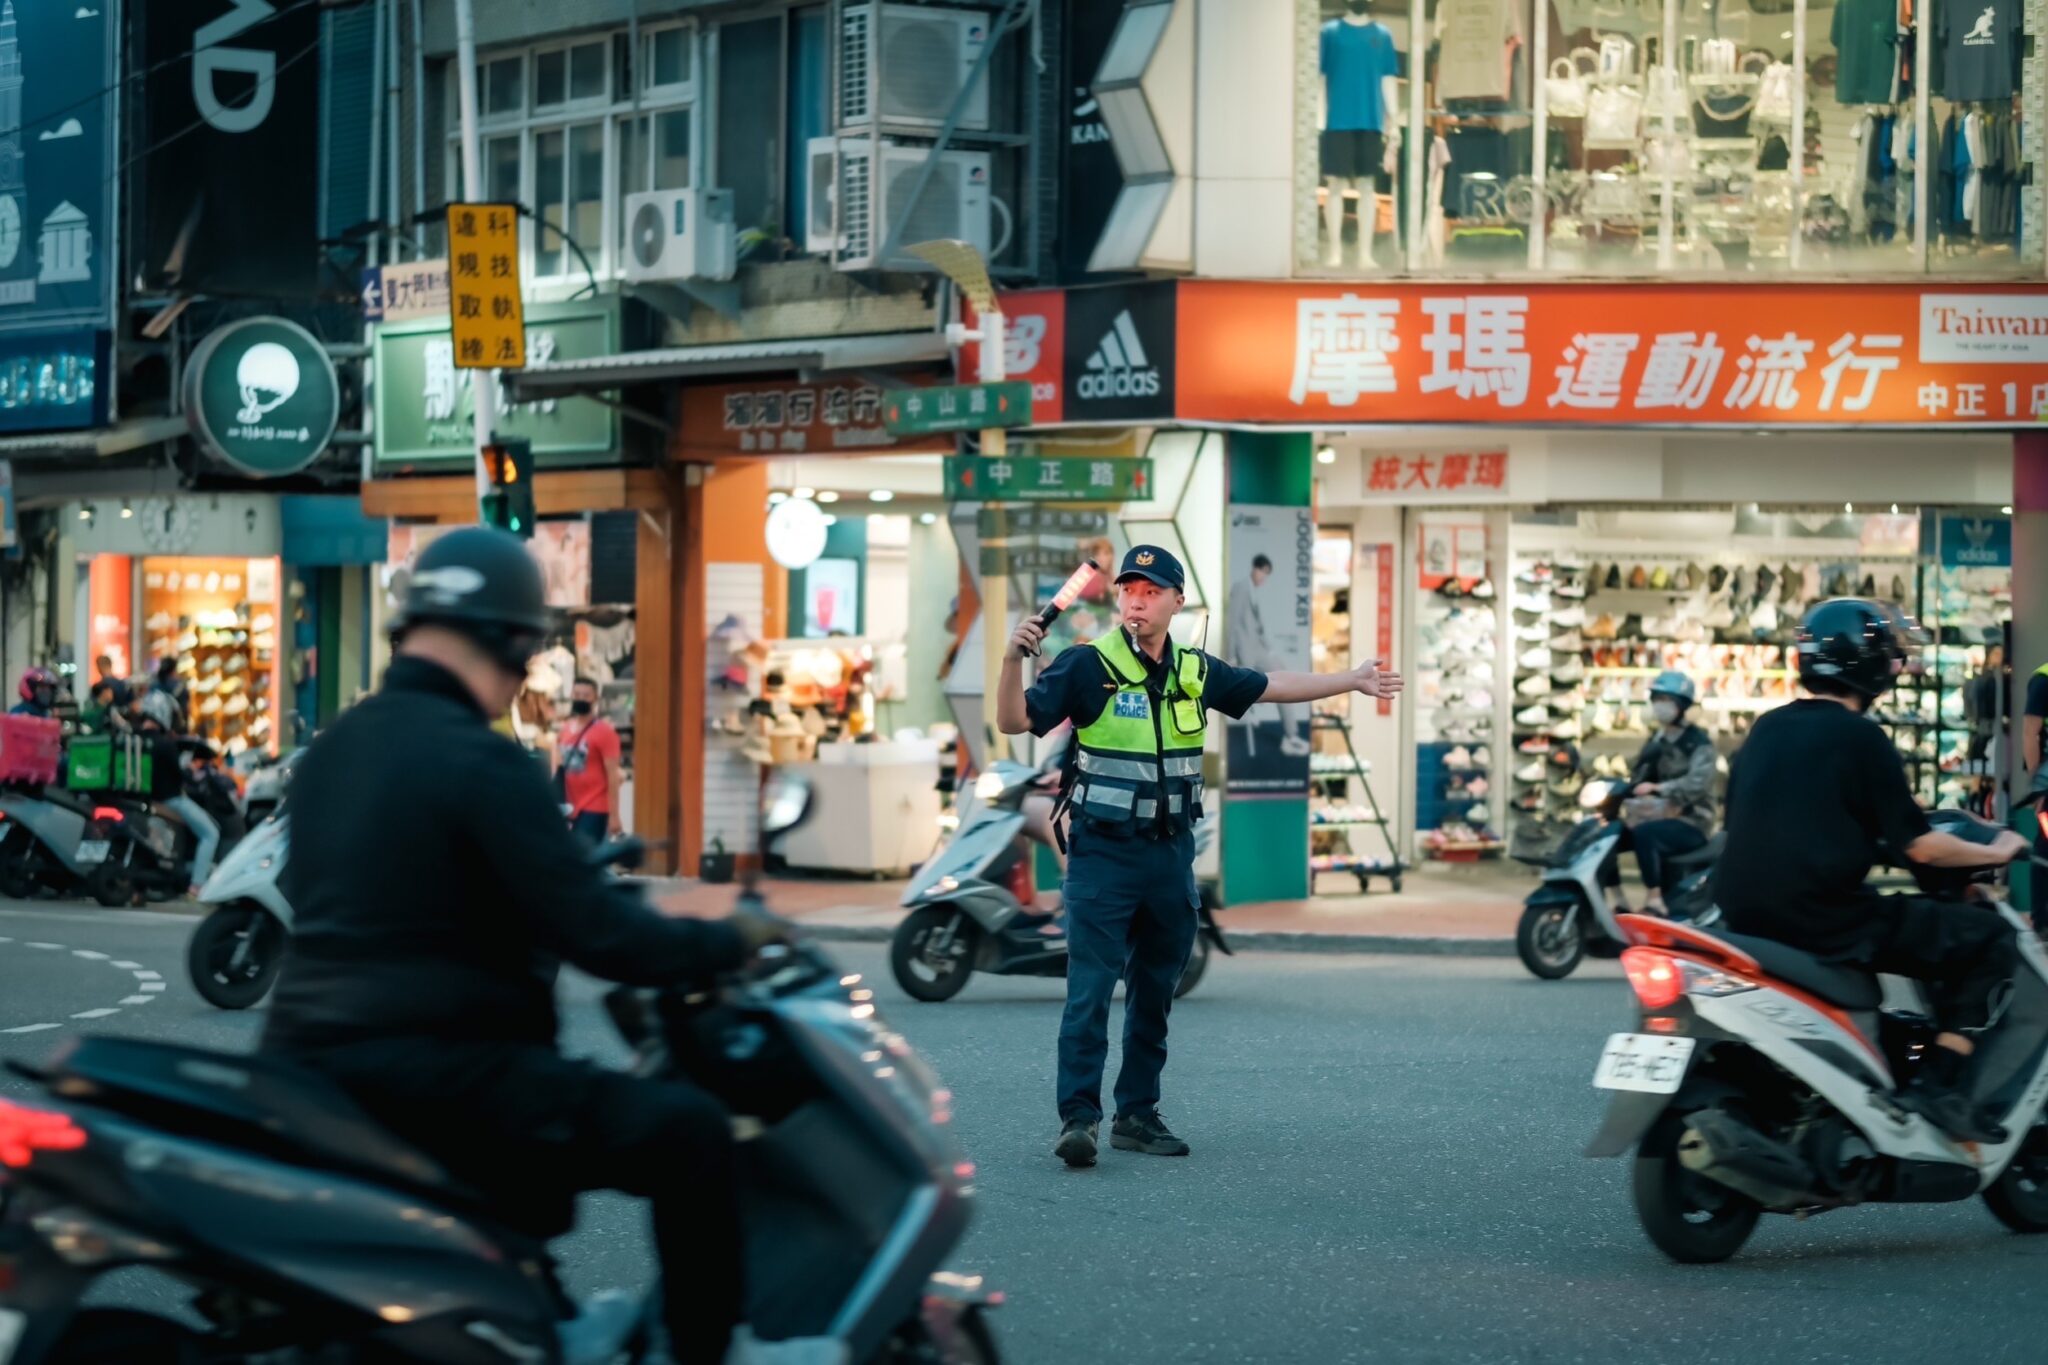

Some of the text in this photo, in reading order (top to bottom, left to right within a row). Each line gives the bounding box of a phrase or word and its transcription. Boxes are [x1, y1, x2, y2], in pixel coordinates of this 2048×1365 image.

[1071, 122, 1110, 145] KAN
[487, 211, 518, 361] 科技執法
[1932, 307, 2048, 336] Taiwan
[1289, 293, 1904, 412] 摩瑪 運動流行
[1077, 367, 1161, 399] adidas
[906, 388, 987, 420] 中山路
[988, 461, 1115, 487] 中正路
[1295, 511, 1311, 589] JOGGER
[1114, 703, 1148, 718] POLICE
